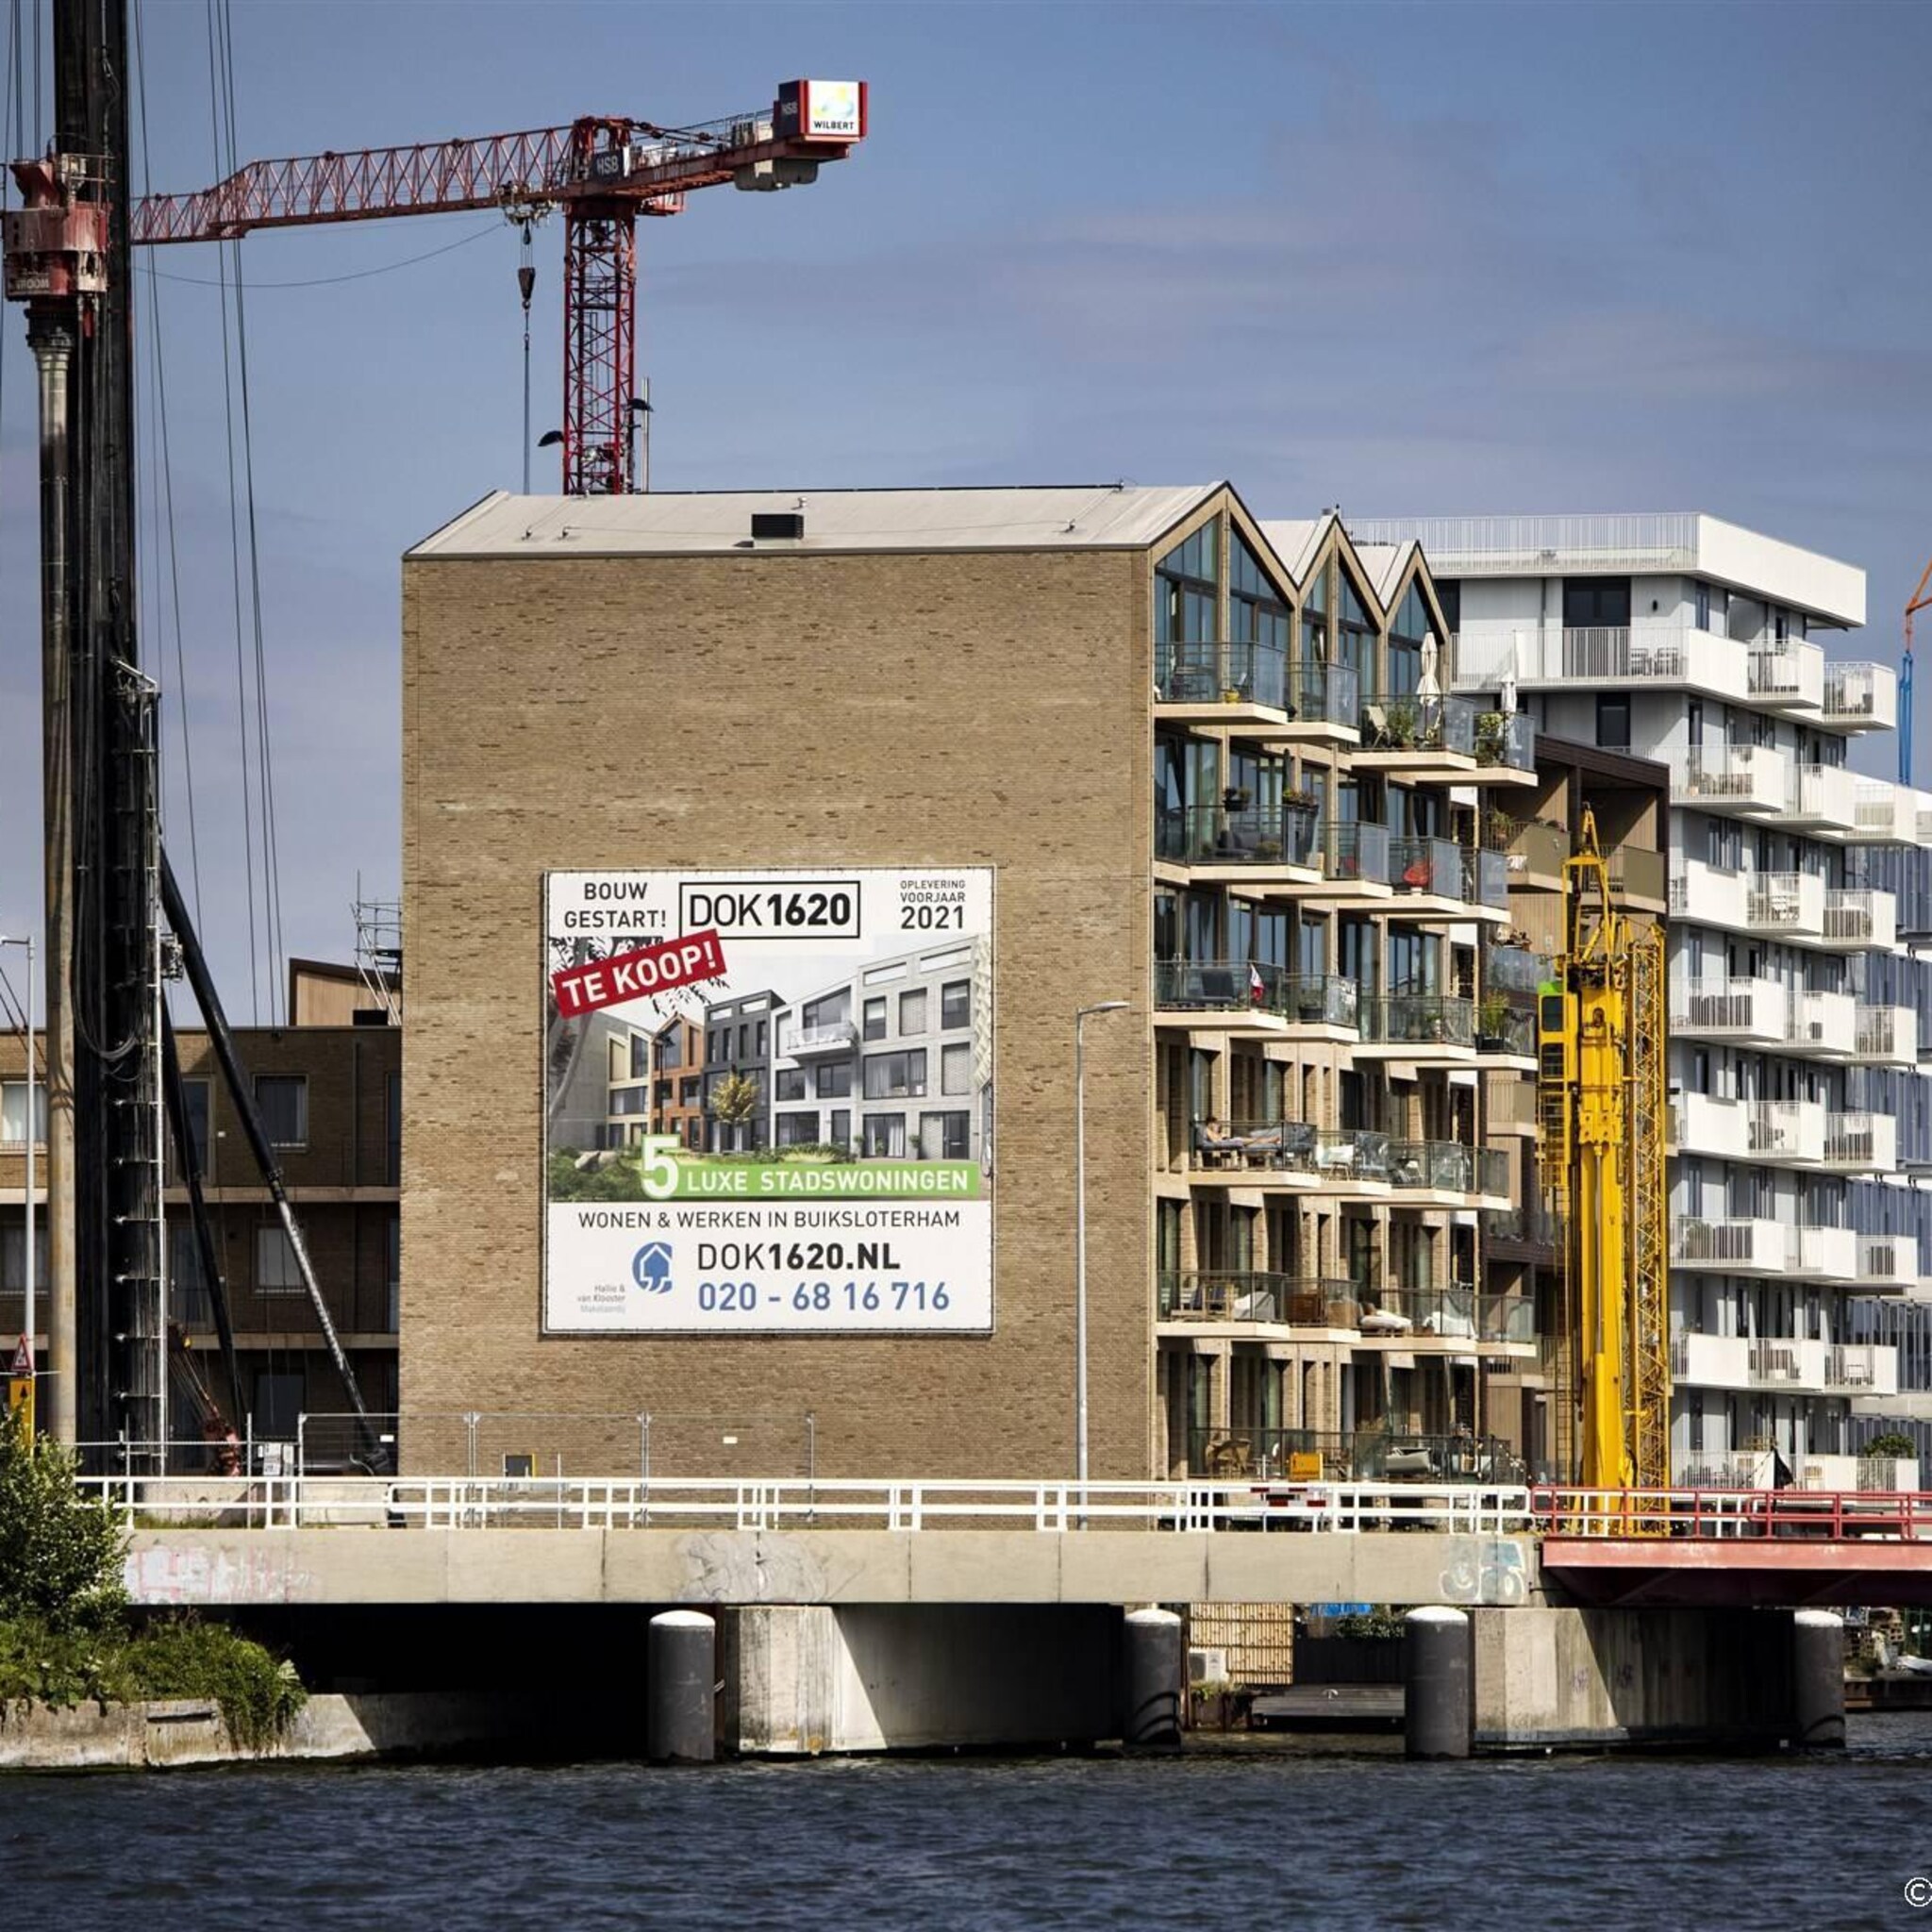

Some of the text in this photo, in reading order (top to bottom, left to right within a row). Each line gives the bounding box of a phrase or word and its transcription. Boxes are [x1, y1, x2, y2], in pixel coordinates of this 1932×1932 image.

[814, 121, 855, 129] WILBERT
[596, 155, 619, 175] HSB
[584, 882, 648, 900] BOUW
[900, 880, 966, 889] OPLEVERING
[900, 891, 966, 903] VOORJAAR
[564, 909, 666, 928] GESTART!
[901, 906, 963, 929] 2021
[562, 941, 717, 1008] TE KOOP!
[642, 1135, 968, 1200] 5 LUXE STADSWONINGEN
[578, 1210, 960, 1228] WONEN & WERKEN IN BUIKSLOTERHAM
[697, 1242, 901, 1270] DOK1620.NL
[698, 1282, 757, 1311] 020
[792, 1282, 831, 1311] 68
[843, 1282, 880, 1311] 16
[891, 1282, 950, 1311] 716
